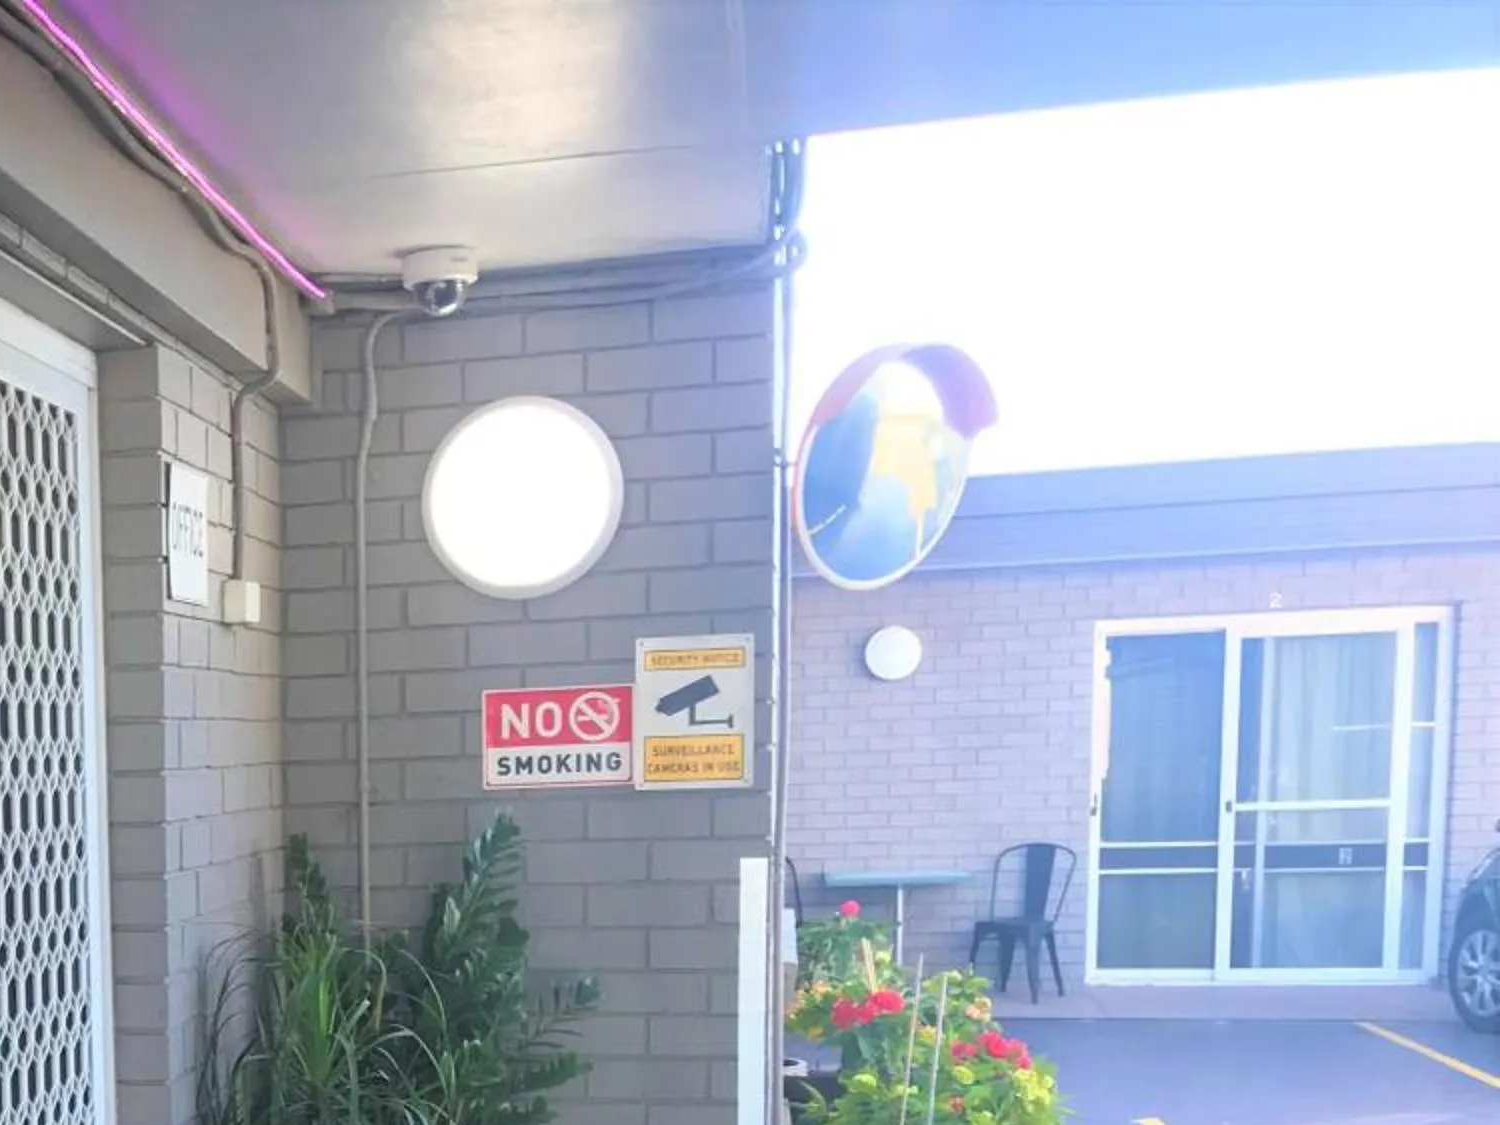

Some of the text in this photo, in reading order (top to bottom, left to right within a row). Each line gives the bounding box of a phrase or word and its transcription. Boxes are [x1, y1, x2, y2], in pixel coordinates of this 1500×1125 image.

[1269, 592, 1282, 608] 2
[651, 652, 741, 667] SECURITY NOTICE
[500, 701, 564, 740] NO
[651, 743, 735, 758] SURVEILLANCE
[496, 752, 623, 776] SMOKING
[647, 760, 741, 774] CAMERAS IN USE
